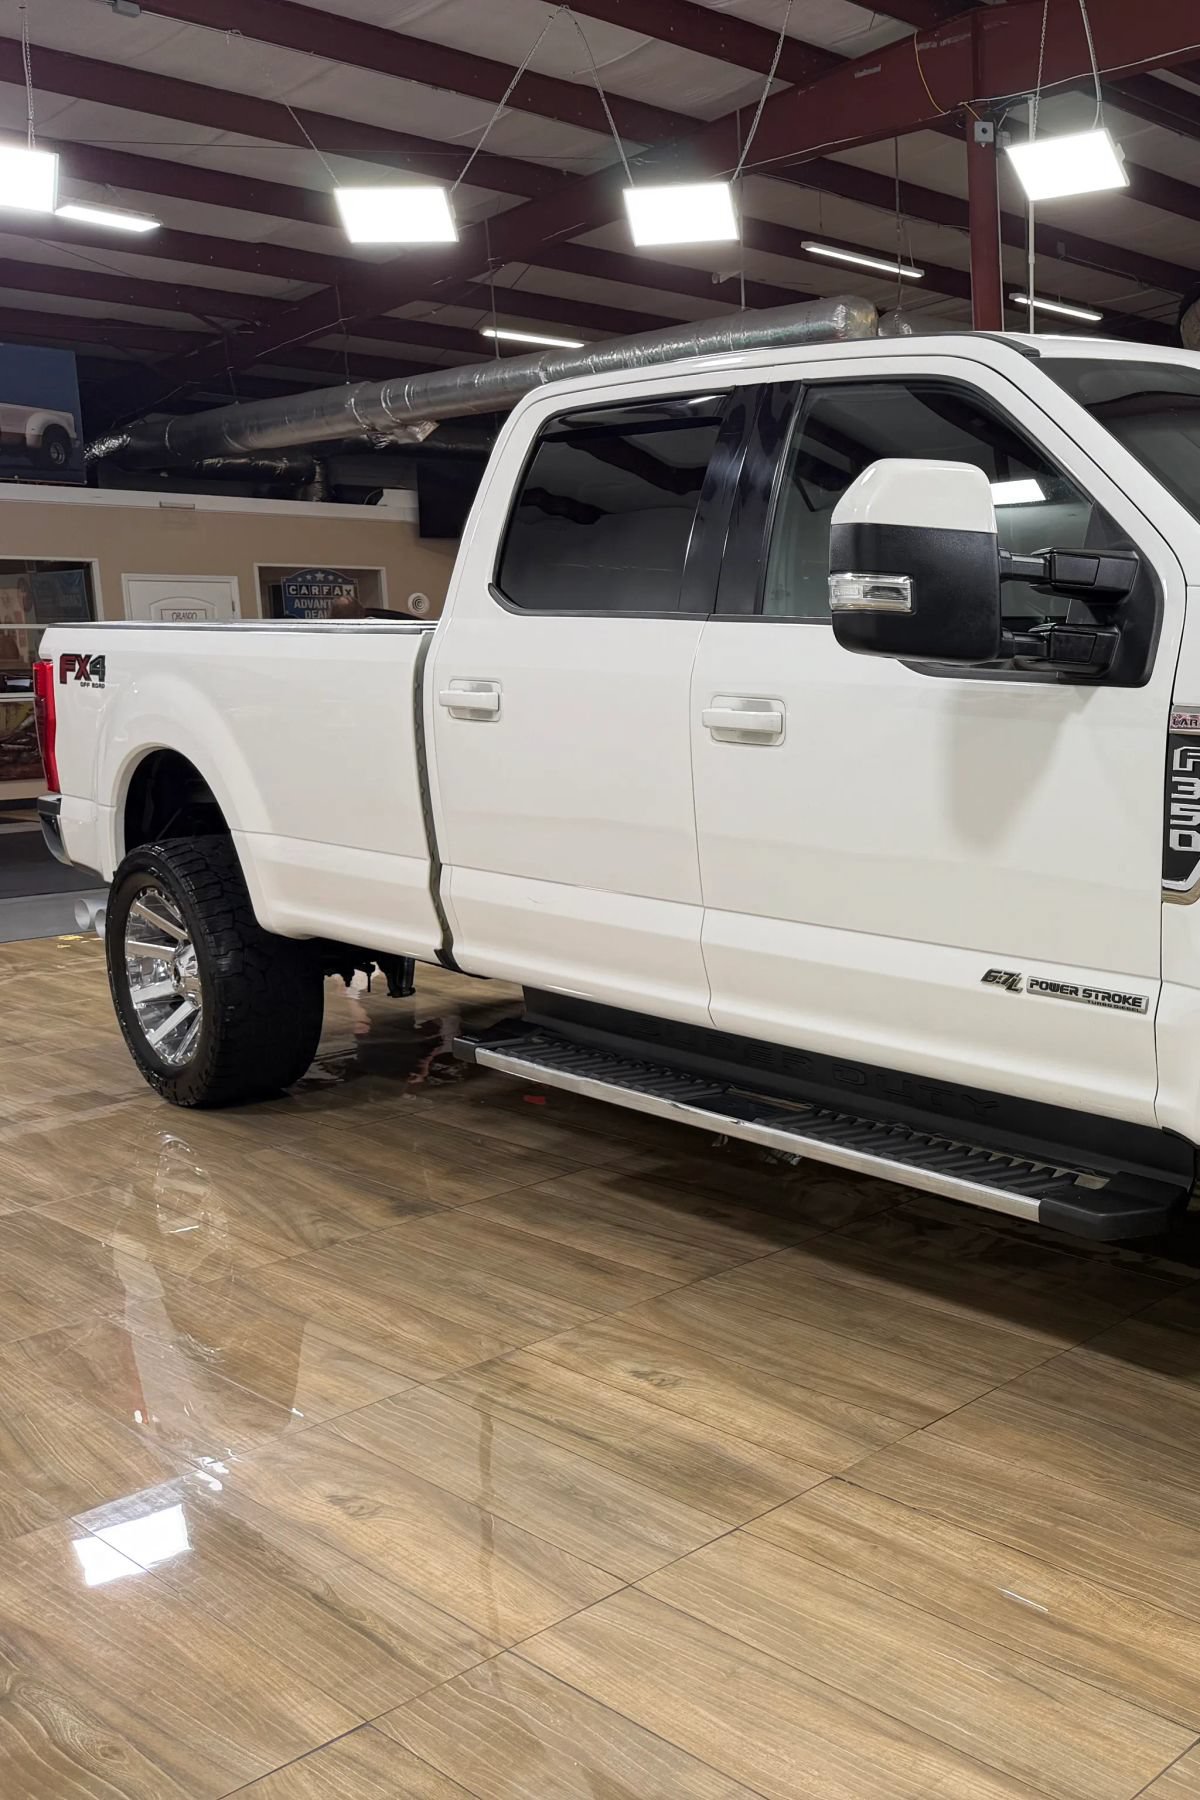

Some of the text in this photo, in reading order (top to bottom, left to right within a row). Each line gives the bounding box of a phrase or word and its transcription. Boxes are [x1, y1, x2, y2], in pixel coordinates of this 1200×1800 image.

[289, 585, 352, 596] CARFAX
[294, 598, 331, 609] ADVANT
[59, 653, 106, 685] FX4
[1029, 979, 1079, 997] POWER
[1082, 988, 1143, 1008] STROKE
